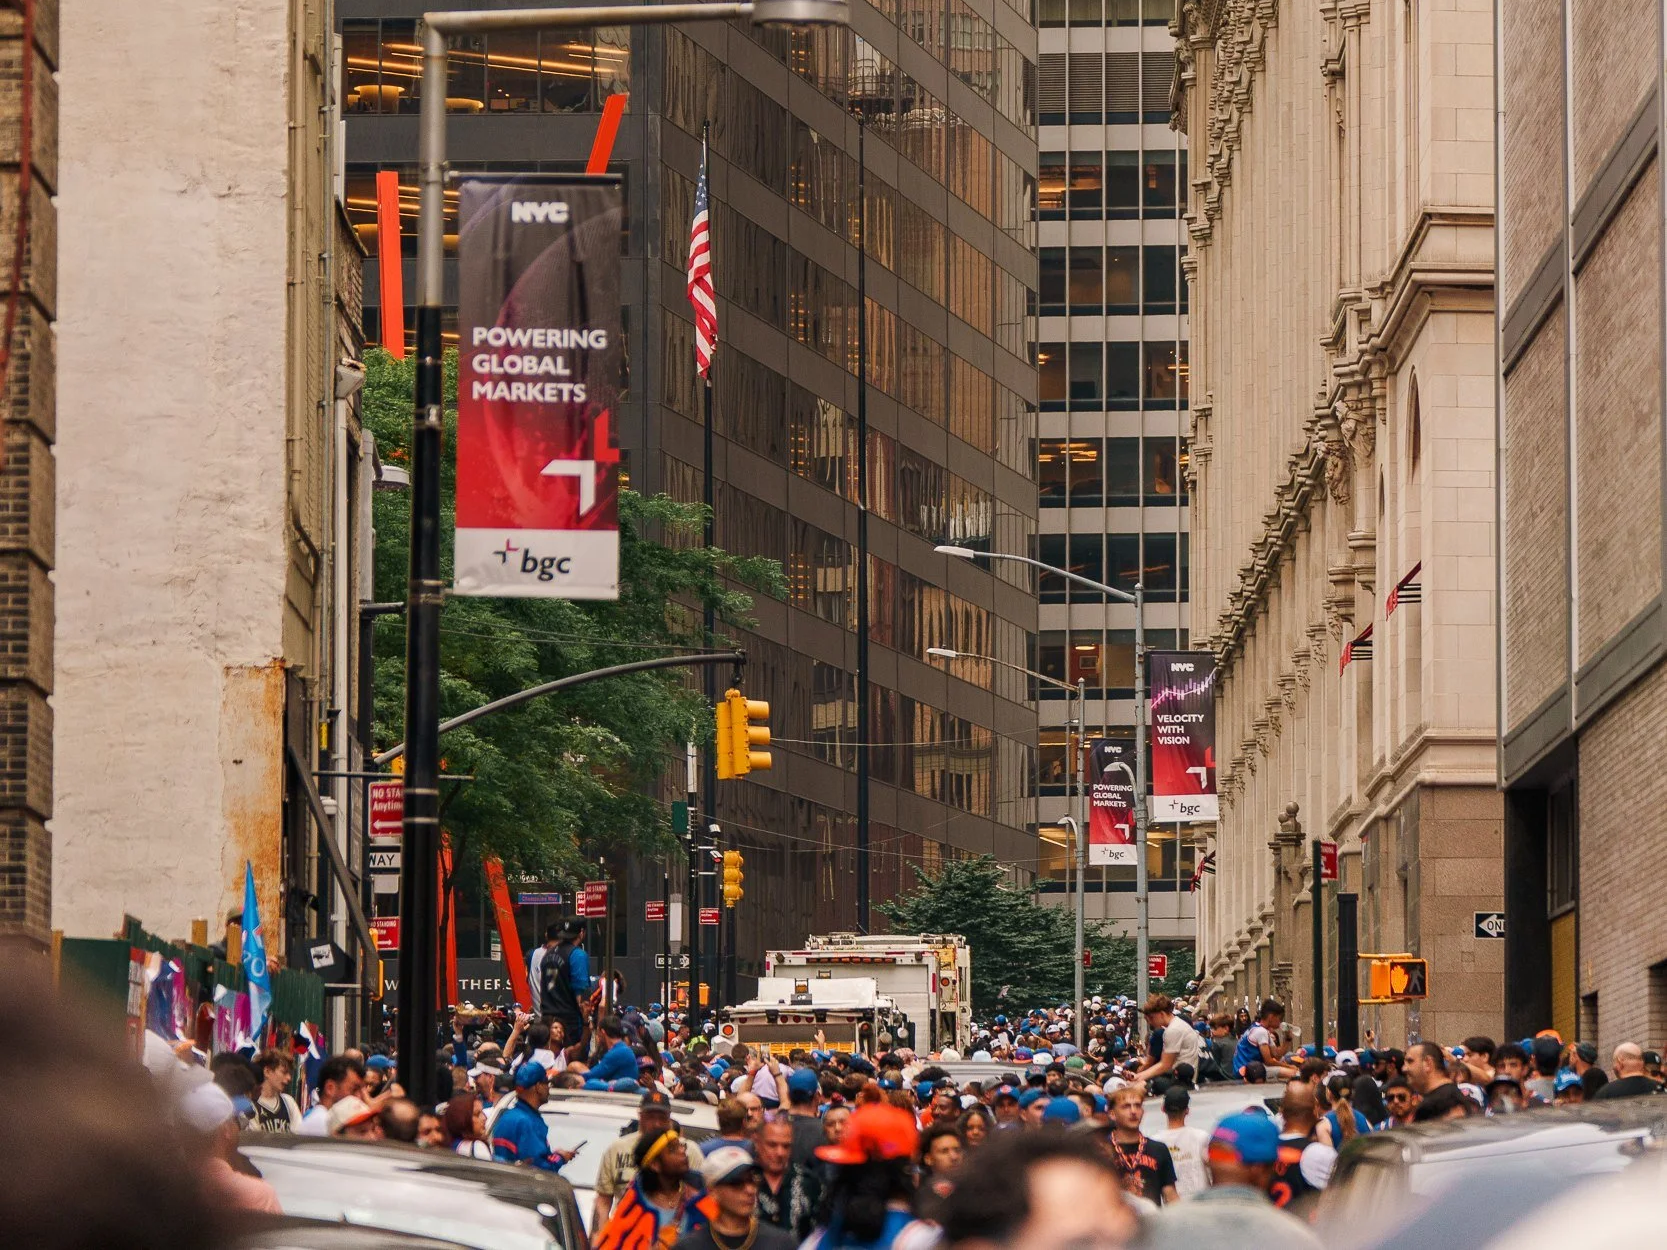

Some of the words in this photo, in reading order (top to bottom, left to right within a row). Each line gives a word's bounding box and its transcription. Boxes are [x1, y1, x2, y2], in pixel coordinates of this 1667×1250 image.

[511, 201, 569, 223] NYC
[472, 327, 608, 350] POWERING
[471, 353, 571, 376] GLOBAL
[472, 380, 587, 403] MARKETS
[520, 548, 571, 582] bgc
[1170, 662, 1195, 672] NYC
[1156, 714, 1204, 724] VELOCITY
[1157, 725, 1184, 734] WITH
[1157, 736, 1190, 745] VISION
[1093, 783, 1132, 791] POWERING
[373, 788, 384, 799] NO
[1093, 792, 1121, 800] GLOBAL
[373, 800, 403, 812] Anytim
[1093, 800, 1127, 808] MARKETS
[1180, 802, 1201, 816] bgc
[1109, 850, 1125, 859] bgc
[1487, 920, 1505, 931] ON
